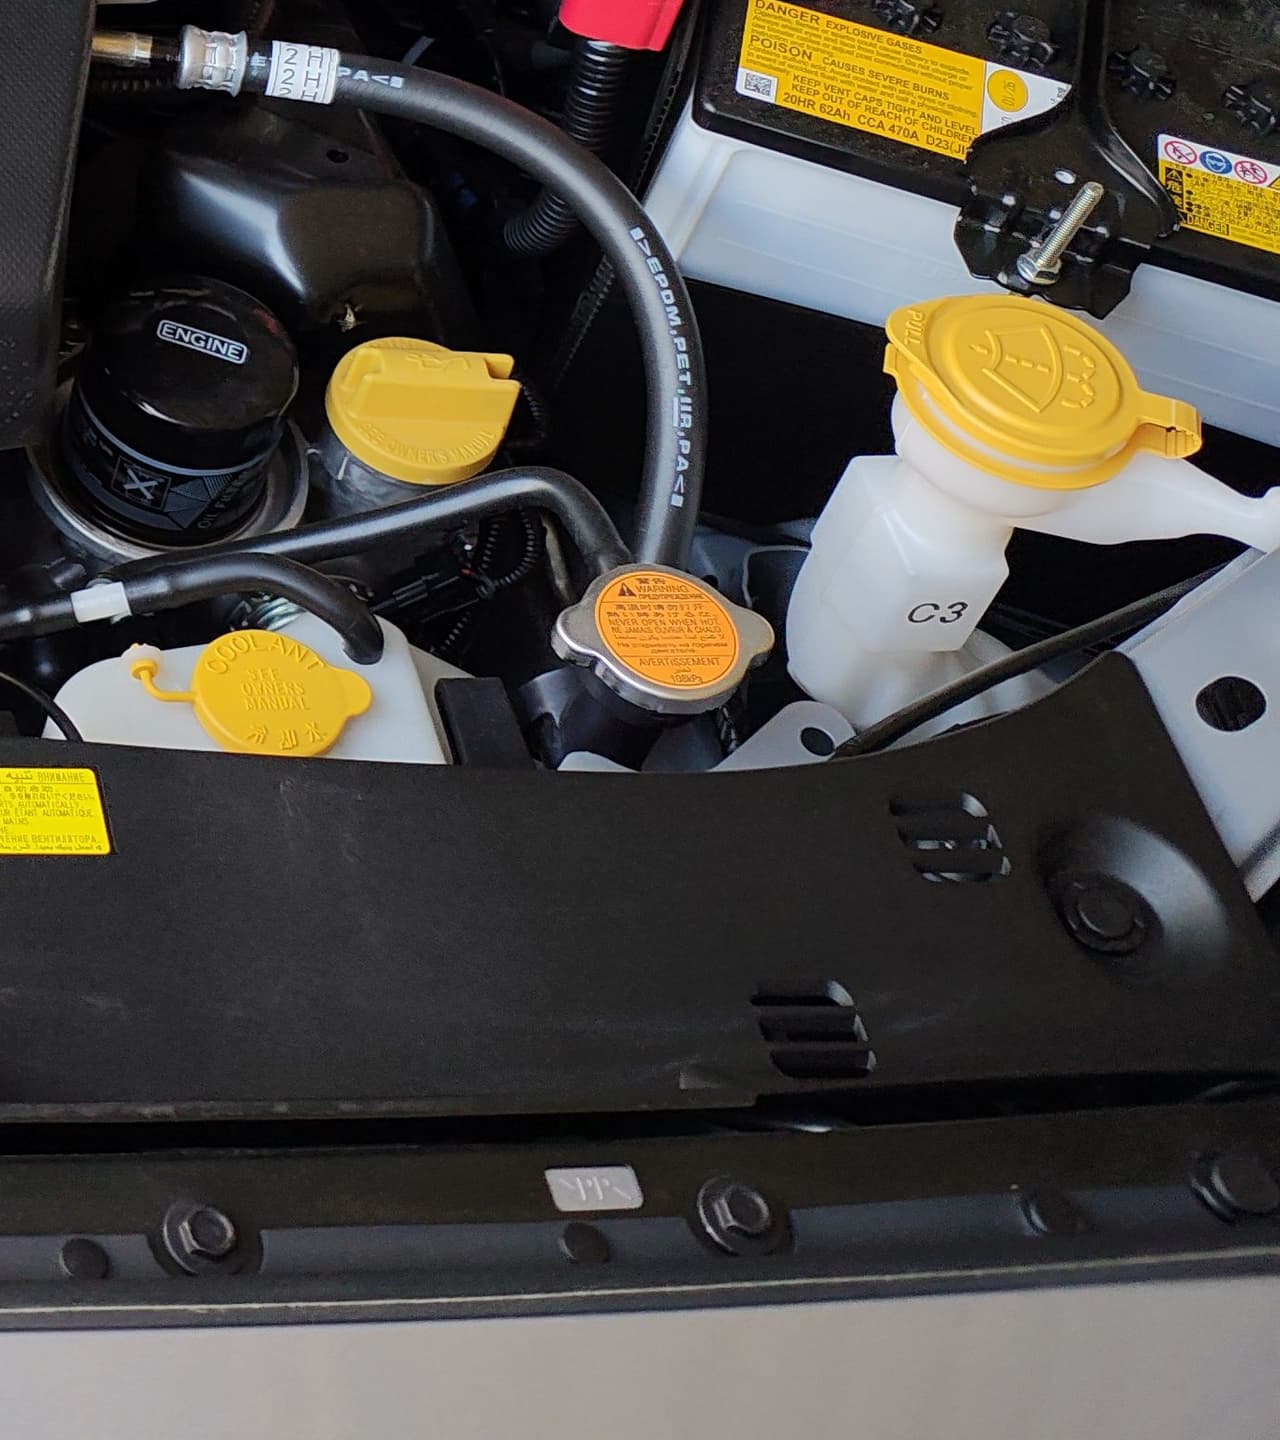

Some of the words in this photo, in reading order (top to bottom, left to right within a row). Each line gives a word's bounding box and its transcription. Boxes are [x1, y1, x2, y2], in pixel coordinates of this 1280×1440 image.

[825, 19, 884, 43] EXPLOSIVE
[885, 36, 921, 54] GASES
[749, 34, 812, 60] POISON
[822, 56, 865, 76] CAUSES
[867, 69, 909, 89] SEVERE
[912, 82, 948, 100] BURNS
[790, 82, 819, 98] KEEP
[822, 92, 845, 106] OUT
[846, 99, 861, 110] OF
[864, 104, 901, 122] REACH
[904, 115, 919, 127] OF
[792, 73, 820, 89] KEEP
[822, 82, 850, 98] VENT
[854, 91, 882, 107] CAPS
[886, 100, 917, 117] TIGHT
[919, 110, 942, 124] AND
[944, 117, 978, 136] LEVEL
[782, 91, 816, 110] 20HR
[819, 102, 850, 120] 62Ah
[857, 113, 885, 131] CCA
[888, 122, 919, 140] 470A
[925, 133, 965, 156] D23(JI
[160, 323, 242, 360] ENGINE
[904, 310, 925, 345] PULL
[361, 423, 385, 441] SEE
[453, 430, 497, 459] MANUAL
[636, 585, 690, 593] WARNING
[609, 618, 639, 626] NEVER
[643, 618, 666, 626] OPEN
[670, 618, 697, 626] WHEN
[907, 601, 968, 623] C3
[206, 633, 326, 675] COOLANT
[639, 658, 720, 666] AVERTISSEMENT
[248, 667, 279, 681] SEE
[244, 696, 311, 711] MANUAL
